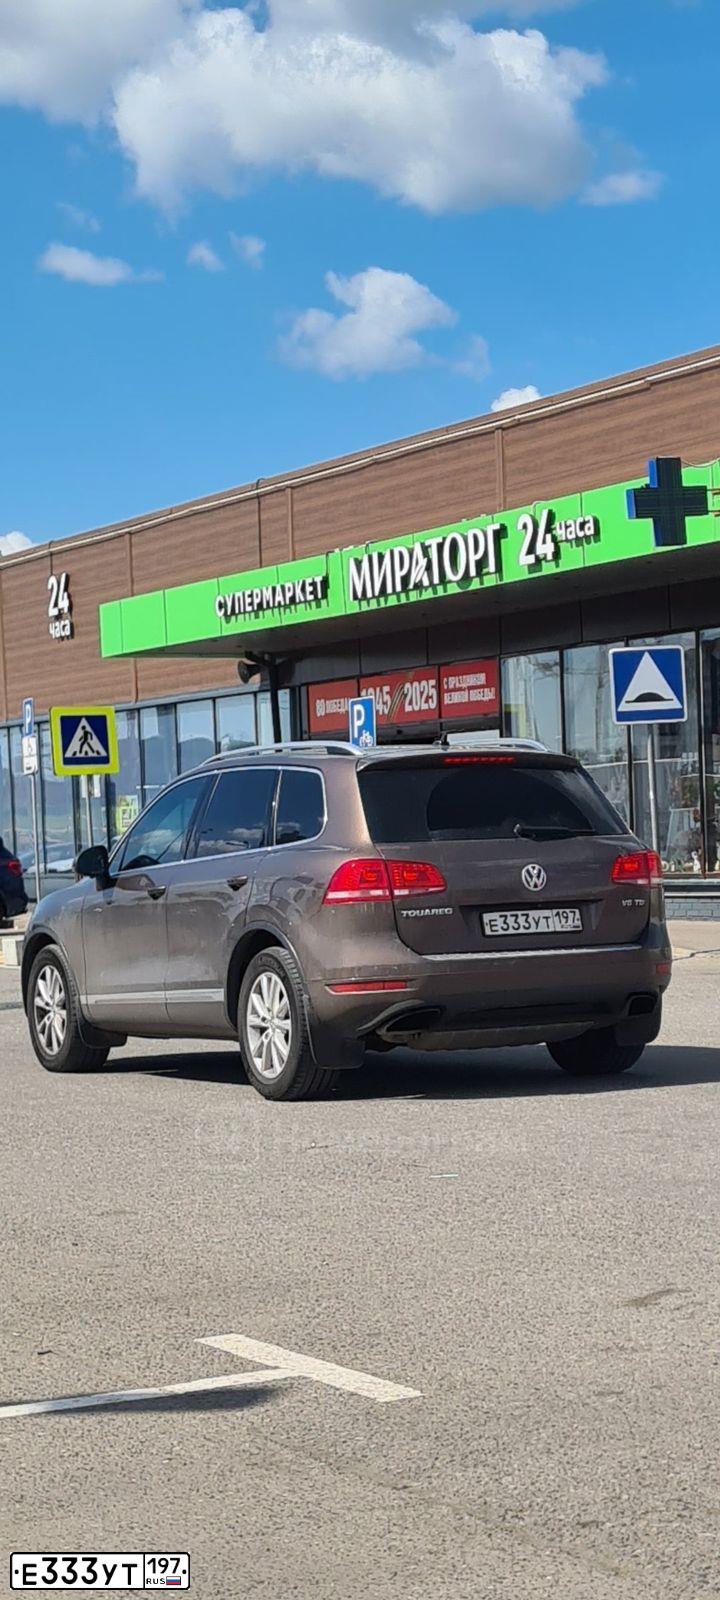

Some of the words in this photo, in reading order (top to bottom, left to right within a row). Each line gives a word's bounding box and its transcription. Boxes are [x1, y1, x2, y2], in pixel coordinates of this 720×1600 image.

[215, 576, 324, 616] СУПЕРМАРКЕТ
[348, 523, 501, 601] МИРАТОРГ
[517, 508, 556, 565] 24
[556, 514, 595, 542] часа
[47, 572, 69, 617] 24
[48, 619, 71, 639] часа
[404, 679, 438, 712] 2025
[24, 703, 32, 734] P
[353, 704, 365, 738] P
[400, 907, 453, 917] TOUAREG
[489, 912, 551, 932] Е333УТ
[555, 910, 577, 924] 197
